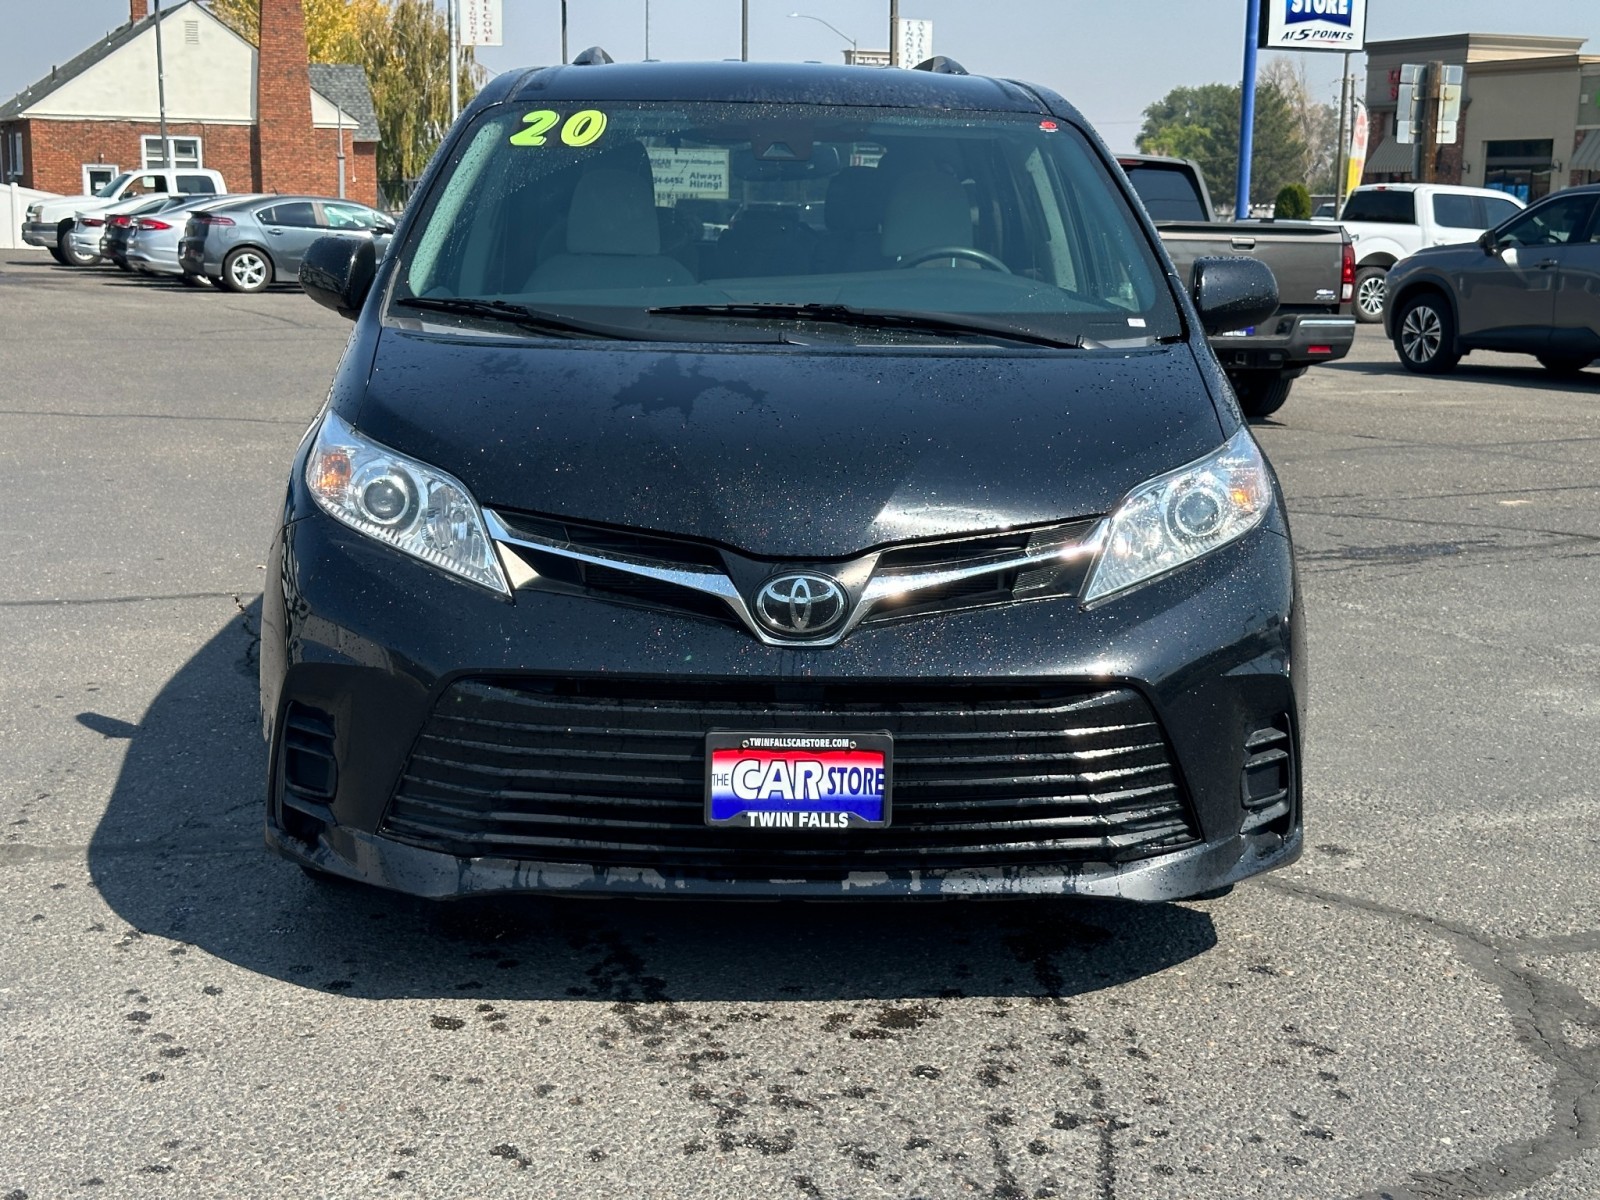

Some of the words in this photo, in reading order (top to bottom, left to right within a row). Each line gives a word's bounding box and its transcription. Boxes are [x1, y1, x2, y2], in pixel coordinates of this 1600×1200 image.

[1290, 0, 1348, 15] STORE
[1281, 31, 1297, 41] AT
[1294, 29, 1312, 41] 5
[1312, 30, 1354, 41] POINTS
[509, 110, 608, 147] 20
[689, 172, 722, 181] Always
[689, 181, 722, 190] Hiring!
[749, 738, 849, 748] TWINFALLSCARSTORE.COM
[712, 773, 729, 786] THE
[731, 759, 824, 800] CAR
[827, 767, 885, 796] STORE
[747, 812, 794, 828] TWIN
[799, 812, 849, 828] FALLS
